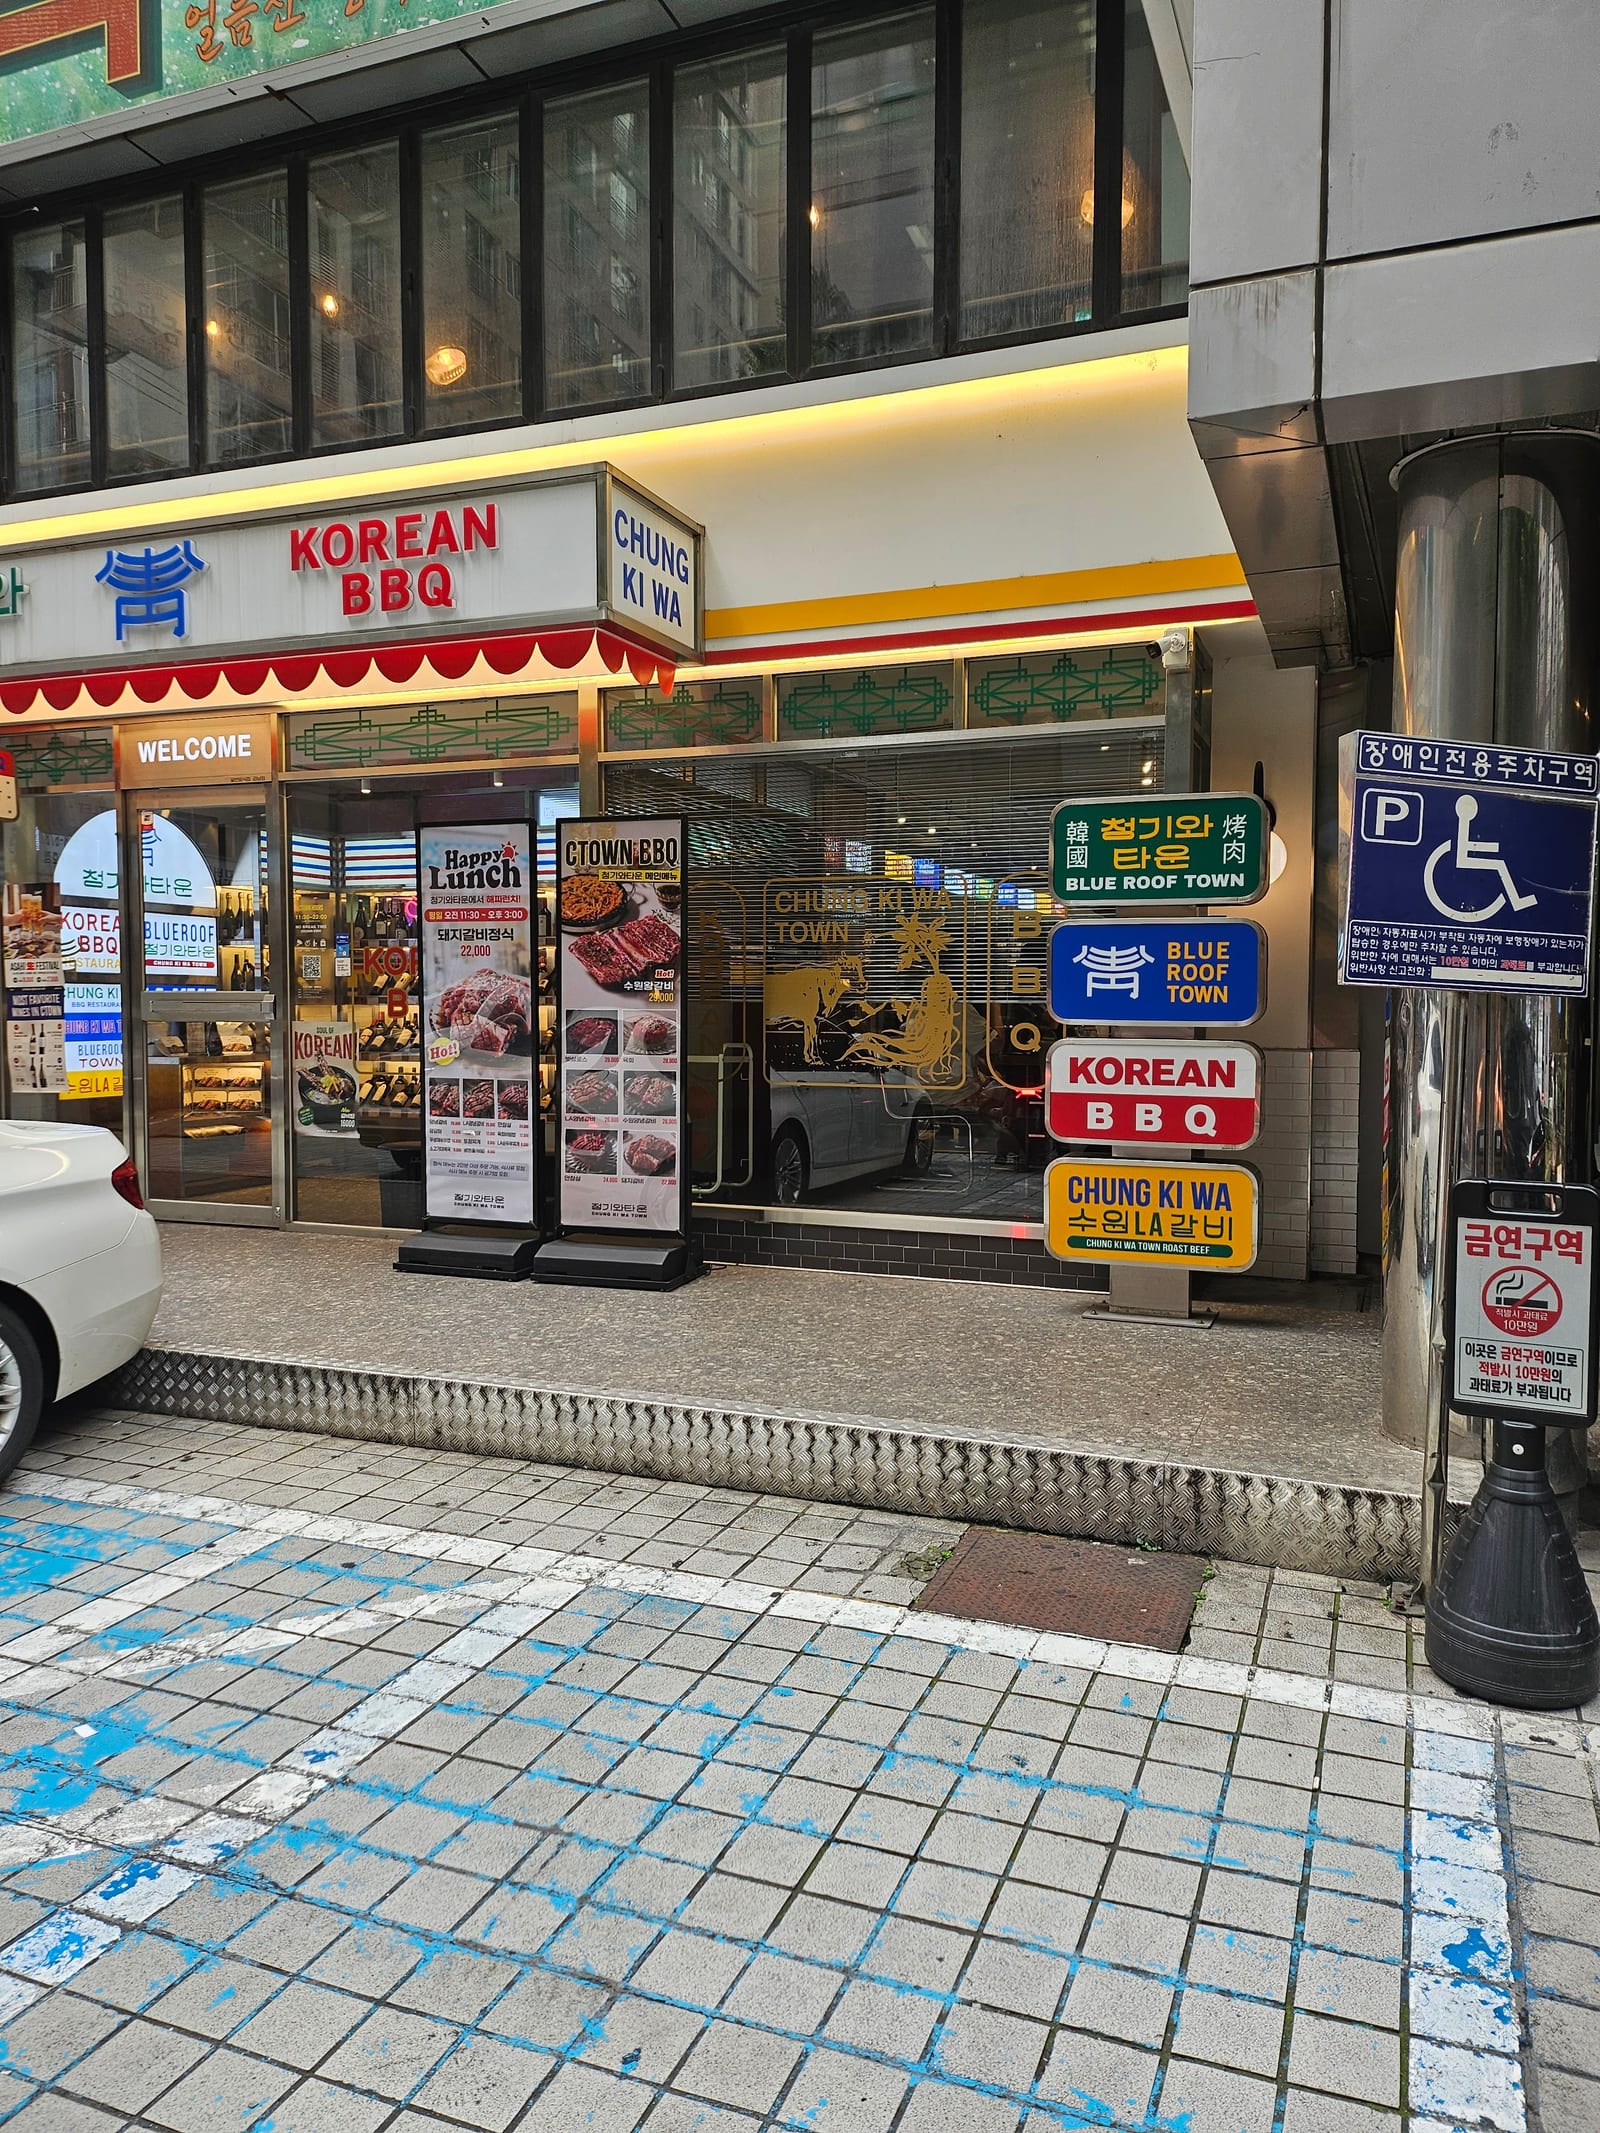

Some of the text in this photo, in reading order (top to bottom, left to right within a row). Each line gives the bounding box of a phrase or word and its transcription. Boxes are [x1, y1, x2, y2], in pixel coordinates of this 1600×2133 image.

[289, 503, 499, 572] KOREAN
[614, 509, 689, 585] CHUNG
[341, 562, 457, 616] BBQ
[623, 562, 682, 628] KI WA
[137, 734, 252, 763] WELCOME
[1365, 740, 1594, 788] 장애인전용주차구역
[1375, 795, 1410, 836] P
[1100, 814, 1215, 841] 청기와
[1066, 820, 1090, 869] 韓國
[1222, 813, 1248, 865] 烤肉
[445, 849, 503, 871] Happy
[565, 838, 678, 868] CTOWN BBQ
[1113, 844, 1191, 870] 타운
[429, 858, 521, 890] Lunch
[601, 872, 643, 880] 청기와타운
[1065, 873, 1245, 891] BLUE ROOF TOWN
[431, 896, 484, 904] 청기와타운에서
[774, 887, 953, 913] CHUNG KI WA
[444, 911, 459, 920] 오전
[460, 911, 480, 919] 11:30
[488, 911, 502, 919] 오후
[504, 910, 523, 919] 3:00
[145, 921, 214, 943] BLUEROOF
[438, 928, 514, 942] 돼지갈비정식
[775, 920, 849, 944] TOWN
[1352, 925, 1381, 938] 장애인
[1382, 927, 1437, 941] 자동차표시가
[1468, 932, 1503, 945] 자동차에
[1505, 935, 1549, 948] 보행장애가
[80, 935, 118, 954] BBQ
[460, 945, 491, 958] 22,000
[1167, 941, 1230, 960] BLUE
[1351, 938, 1499, 957] 탑승한 경우에만 주차할 수 있습니다.
[1349, 962, 1426, 977] 위반사항 신고전화
[1350, 950, 1379, 963] 위반한
[1381, 952, 1399, 964] 자에
[1402, 953, 1438, 966] 대해서는
[1472, 957, 1498, 970] 이하의
[1166, 963, 1230, 982] ROOF
[107, 987, 118, 999] KI
[623, 981, 674, 991] 수원왕갈비
[1166, 985, 1228, 1003] TOWN
[429, 1042, 458, 1061] Hot!
[1069, 1056, 1236, 1088] KOREAN
[454, 1193, 504, 1204] 청기와타운
[1068, 1175, 1232, 1212] CHUNG KI WA
[592, 1203, 647, 1213] 청기와타운
[1086, 1238, 1210, 1255] CHUNG KI WA TOWN ROAST BEEF
[1464, 1223, 1583, 1265] 금연구역
[1522, 1310, 1548, 1320] 과태료
[1504, 1320, 1538, 1333] 10만원
[1465, 1342, 1578, 1368] 이곳은 금연구역이므로
[1478, 1361, 1562, 1384] 적발시 10만원의
[1469, 1377, 1572, 1402] 과태료가 부과됩니다
